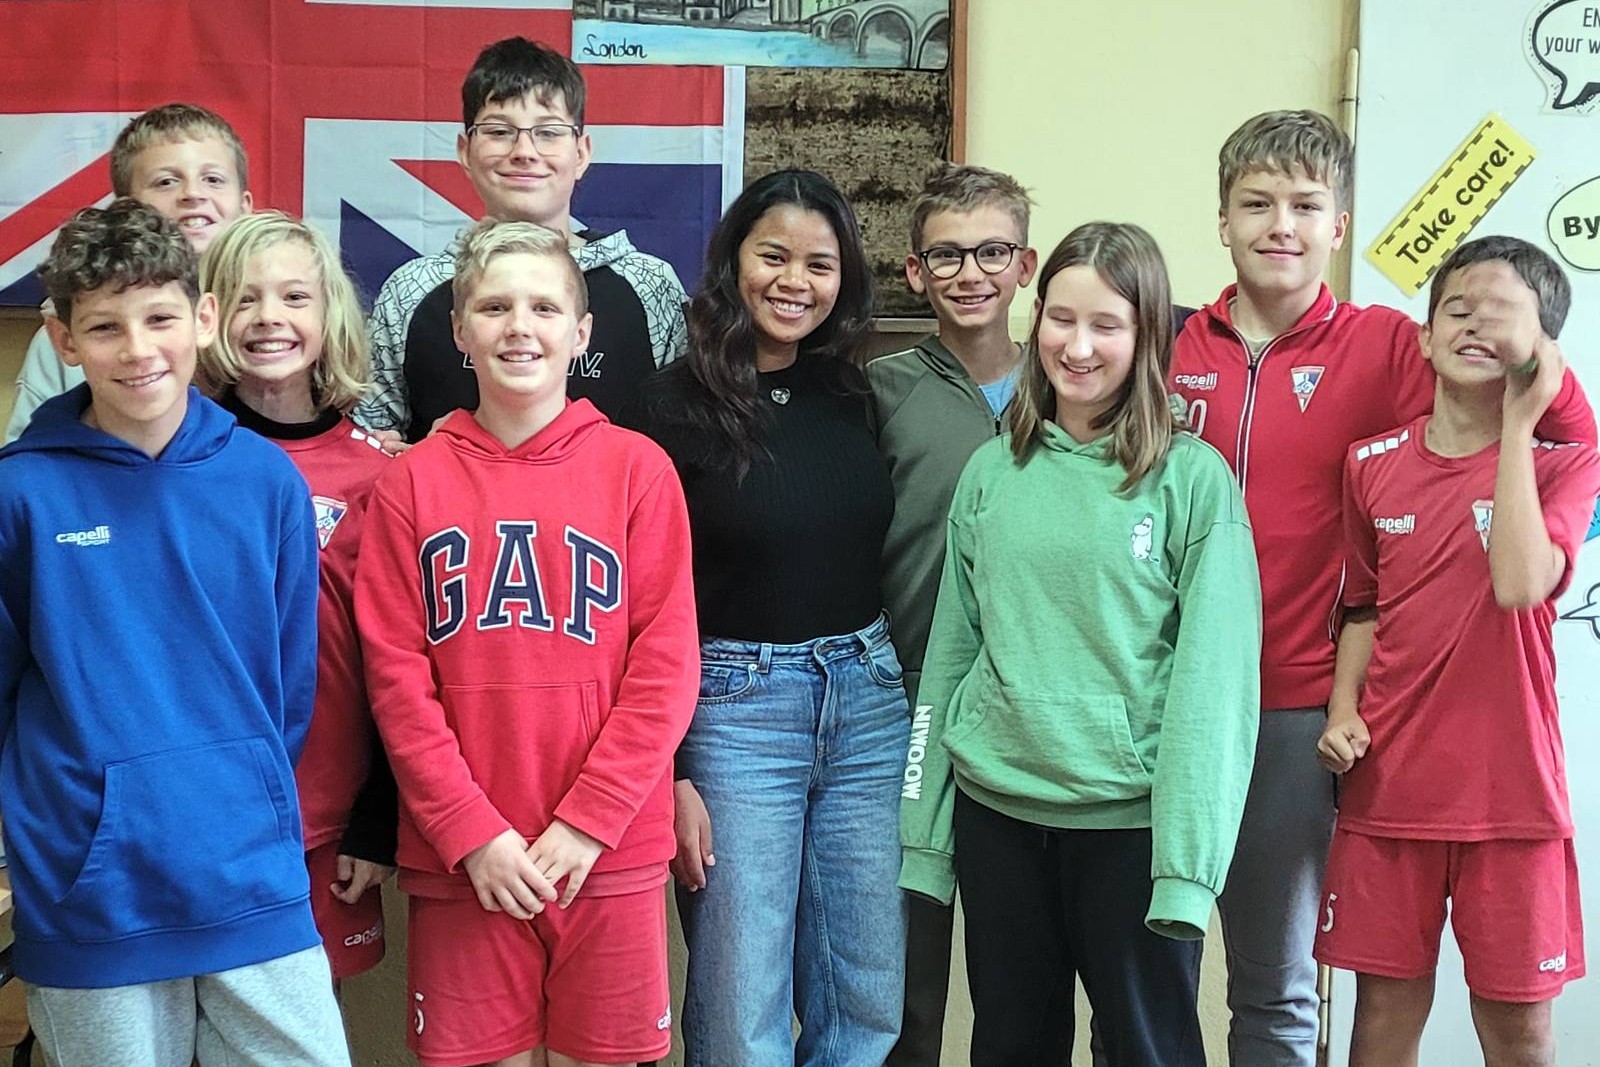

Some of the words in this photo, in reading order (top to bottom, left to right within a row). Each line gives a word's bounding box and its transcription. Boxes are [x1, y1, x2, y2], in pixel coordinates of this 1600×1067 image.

[582, 33, 648, 59] London
[1544, 36, 1584, 56] your
[1395, 207, 1456, 264] Take
[1455, 138, 1515, 206] care!
[1563, 215, 1600, 240] By
[1175, 372, 1218, 388] capelli
[56, 525, 111, 545] capelli
[1374, 514, 1416, 532] capelli
[418, 520, 623, 646] GAP
[901, 704, 934, 800] MOOMIN
